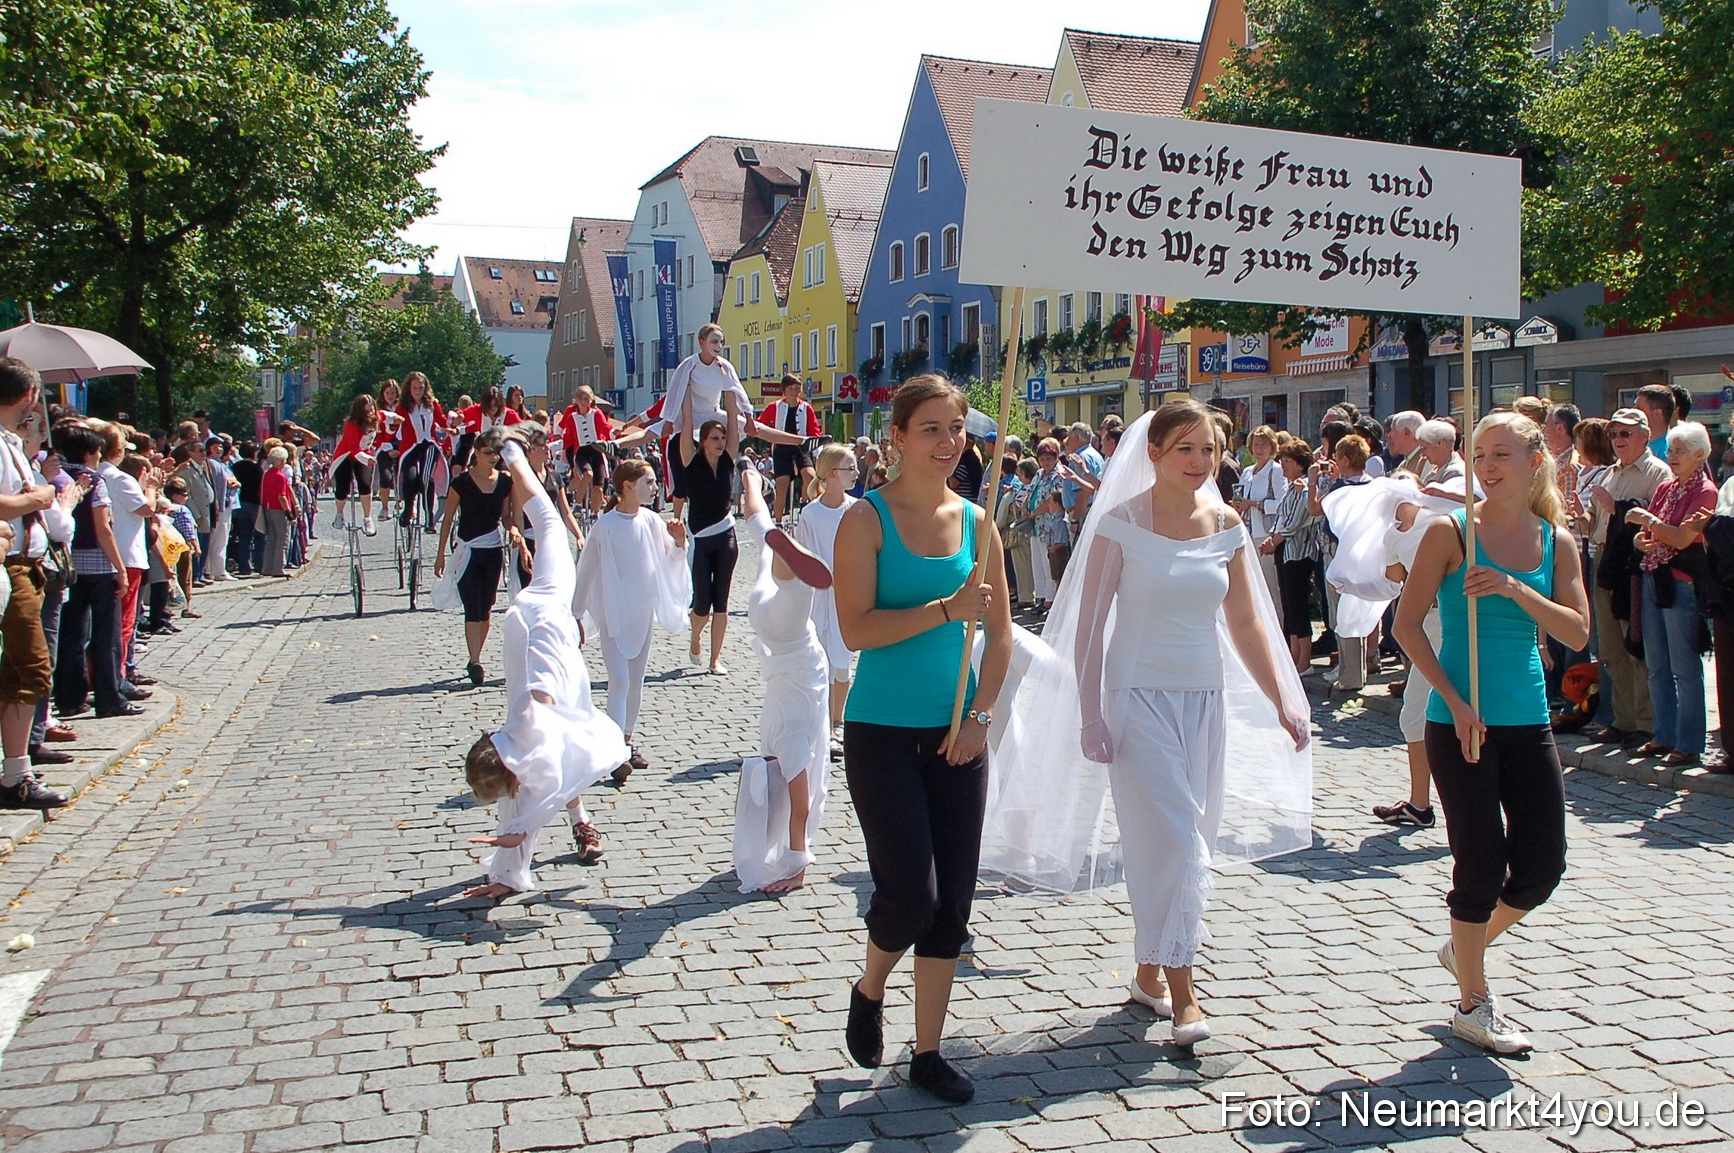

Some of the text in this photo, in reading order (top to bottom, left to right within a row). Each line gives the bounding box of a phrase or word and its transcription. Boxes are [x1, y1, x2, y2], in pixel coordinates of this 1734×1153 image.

[1083, 125, 1432, 198] Die weiße Frau und
[1065, 173, 1460, 252] ihr Gefolge zeigen Euch
[1086, 221, 1421, 291] den Weg zum Schatz
[665, 289, 674, 334] RUPPERT
[743, 321, 761, 337] HOTEL
[1314, 335, 1334, 348] Mode
[1179, 345, 1187, 389] KINO
[1234, 361, 1267, 371] Reisebüro
[1031, 381, 1041, 400] P
